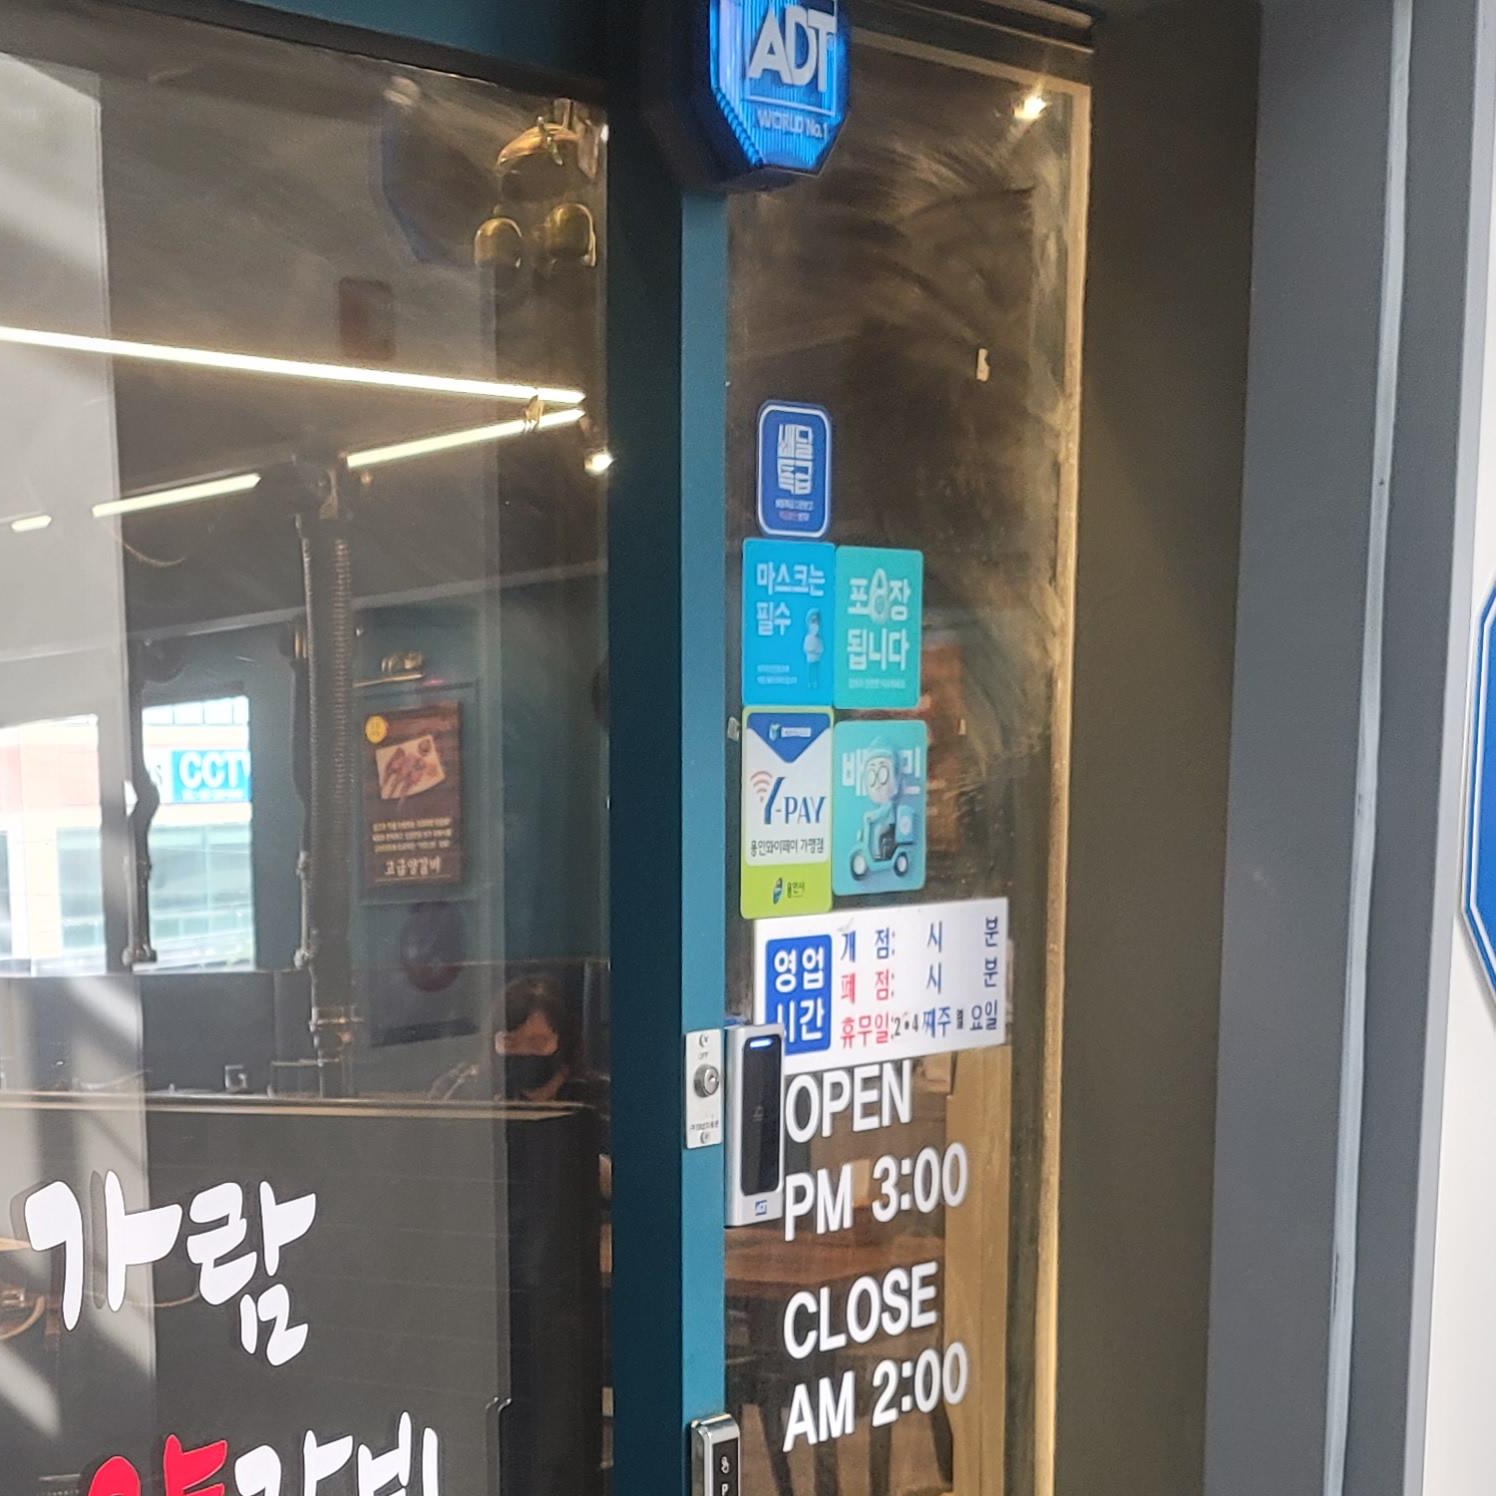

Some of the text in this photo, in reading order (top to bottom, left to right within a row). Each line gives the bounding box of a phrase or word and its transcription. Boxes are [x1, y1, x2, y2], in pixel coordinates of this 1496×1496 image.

[747, 5, 837, 92] ADT
[756, 109, 804, 134] WORLD
[756, 561, 826, 597] 마스크는
[756, 601, 792, 636] 필수
[847, 627, 910, 671] 됩니다
[927, 920, 943, 953] 시
[984, 916, 999, 948] 분
[774, 946, 824, 993] 영업
[927, 962, 942, 995] 시
[983, 957, 998, 988] 분
[784, 1060, 912, 1143] OPEN
[784, 1142, 969, 1242] PM 3:00
[24, 1170, 317, 1366] 가람
[783, 1260, 938, 1360] CLOSE
[783, 1342, 968, 1453] AM 2:00
